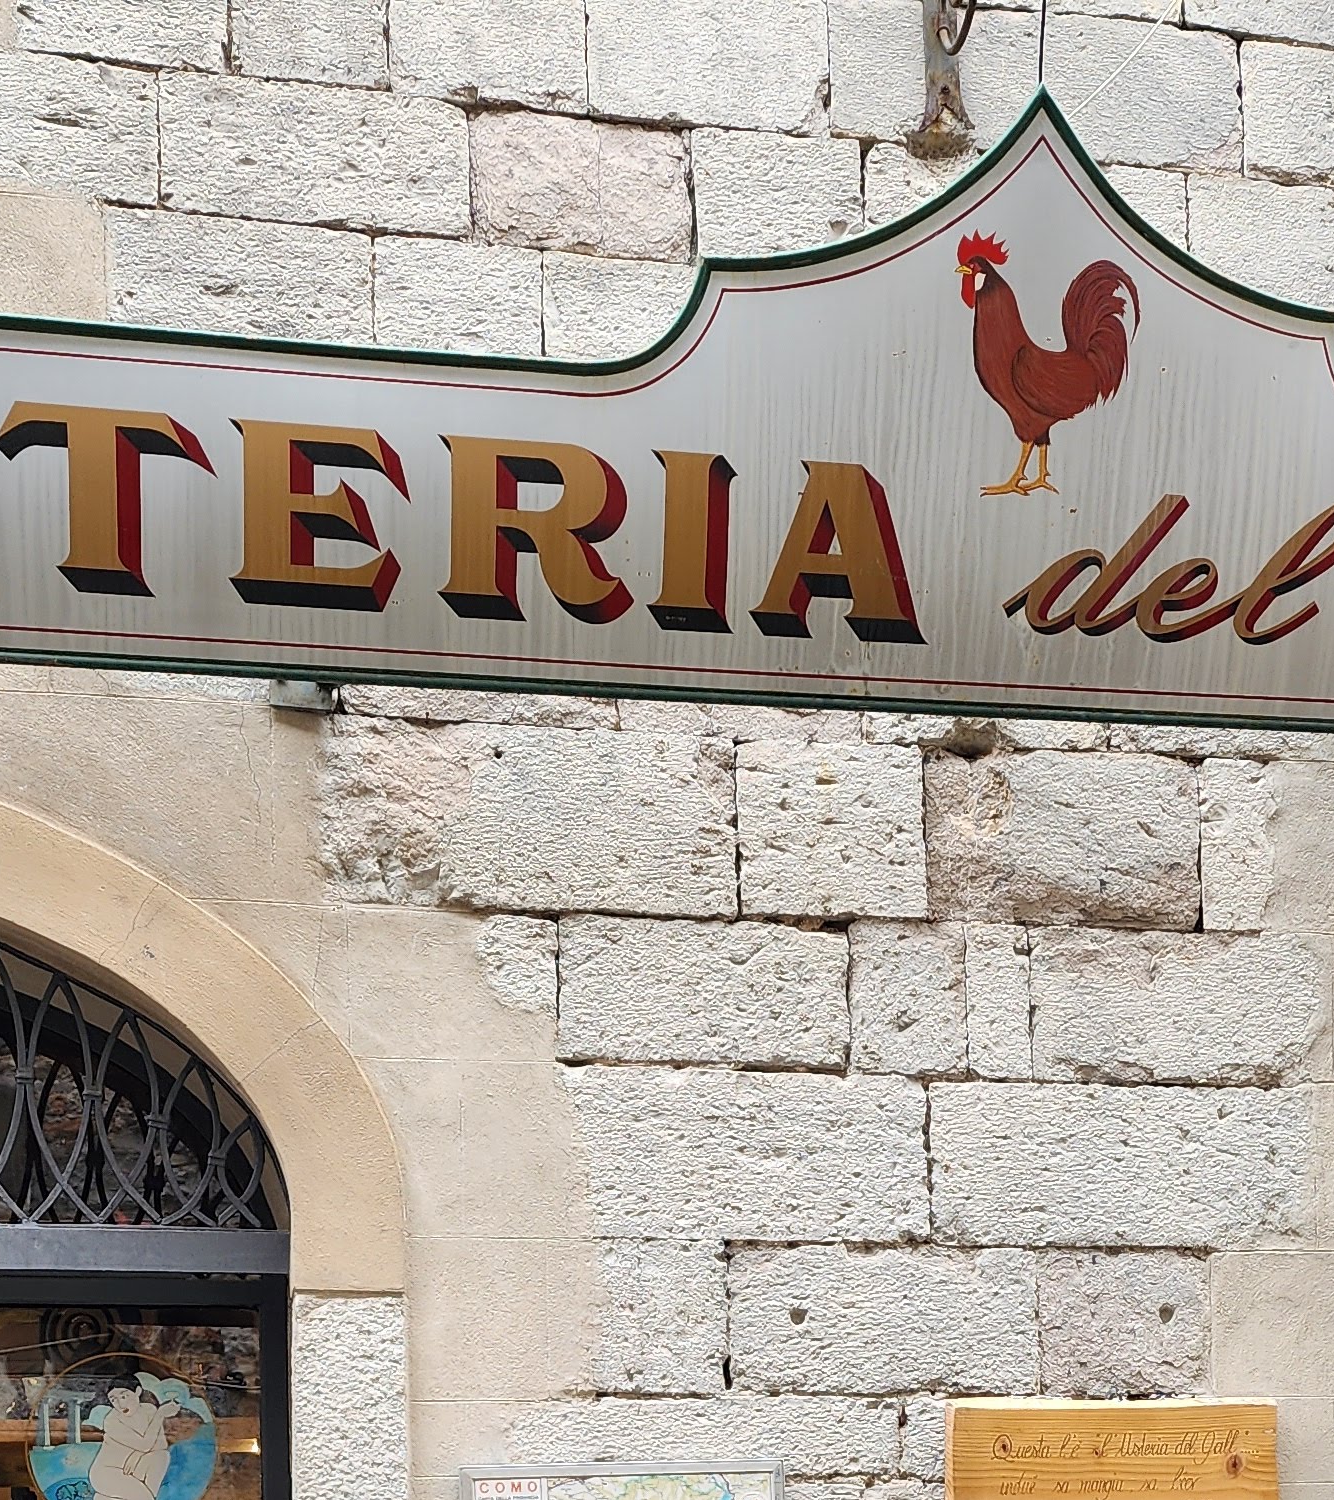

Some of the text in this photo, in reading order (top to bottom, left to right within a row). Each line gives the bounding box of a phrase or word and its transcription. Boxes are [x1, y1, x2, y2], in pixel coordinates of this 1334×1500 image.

[991, 1434, 1051, 1463] Questa
[1175, 1432, 1199, 1455] del
[479, 1481, 538, 1494] COMO
[1053, 1481, 1071, 1494] sa
